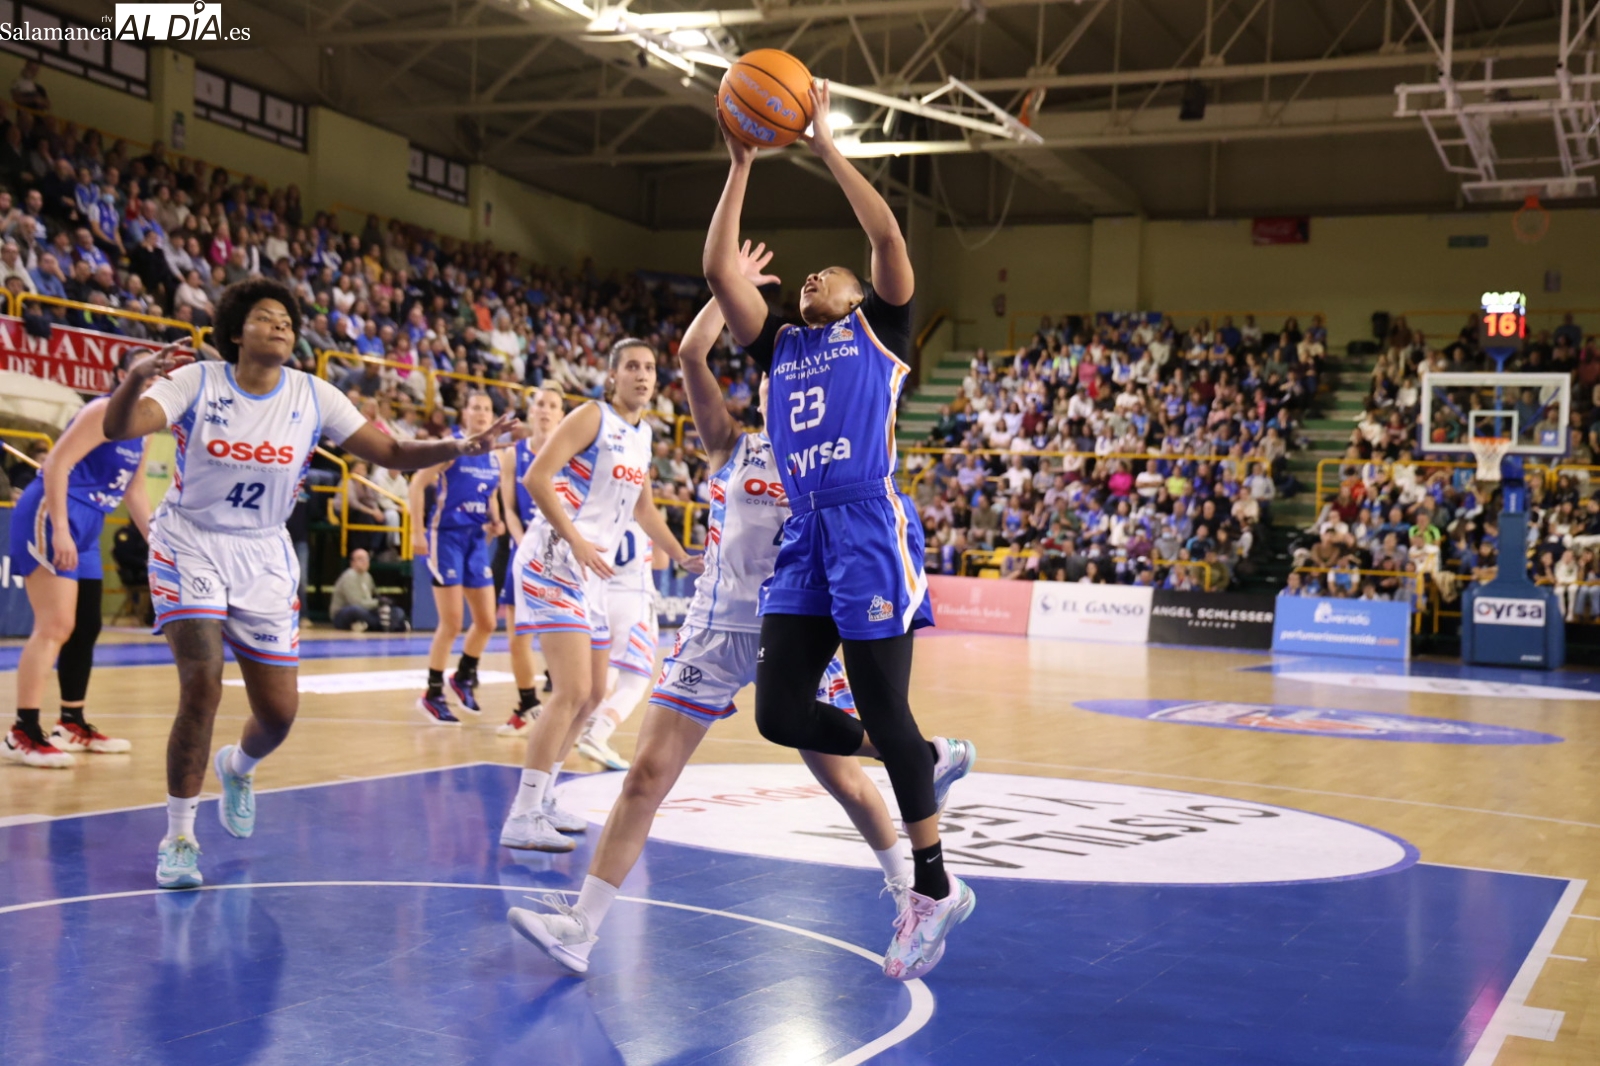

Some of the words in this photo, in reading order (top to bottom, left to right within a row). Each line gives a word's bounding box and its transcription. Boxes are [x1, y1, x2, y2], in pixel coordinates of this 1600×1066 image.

[1483, 313, 1516, 337] 16
[0, 322, 130, 367] AMANC
[813, 352, 822, 366] Y
[823, 343, 859, 362] LEÓN
[789, 386, 826, 433] 23
[225, 482, 266, 510] 42
[1062, 600, 1079, 612] EL
[1085, 600, 1144, 616] GANSO
[1152, 605, 1193, 618] ANGEL
[1197, 607, 1275, 623] SCHLESSER
